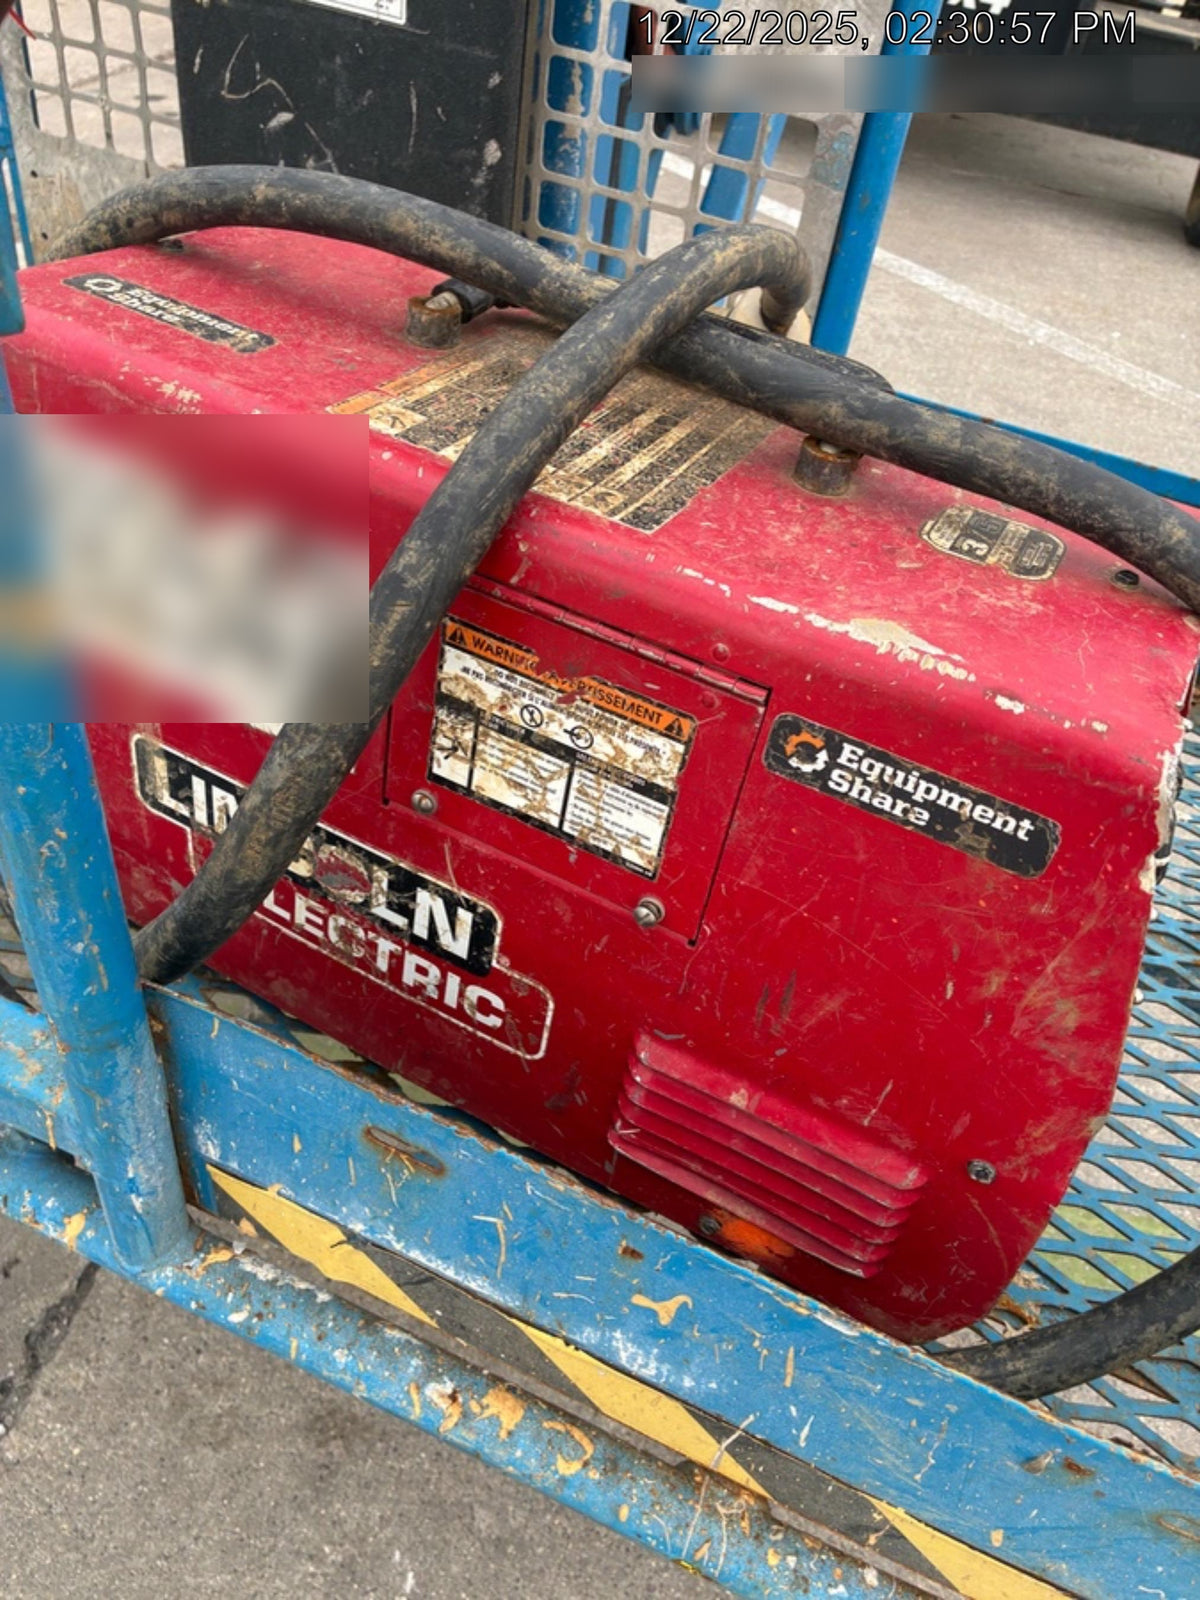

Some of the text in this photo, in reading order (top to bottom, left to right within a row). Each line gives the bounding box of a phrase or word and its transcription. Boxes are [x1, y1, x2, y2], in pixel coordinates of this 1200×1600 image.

[107, 292, 181, 323] Share
[828, 768, 930, 826] Share
[836, 742, 1034, 842] Equipment
[262, 890, 506, 1029] LECTRIC
